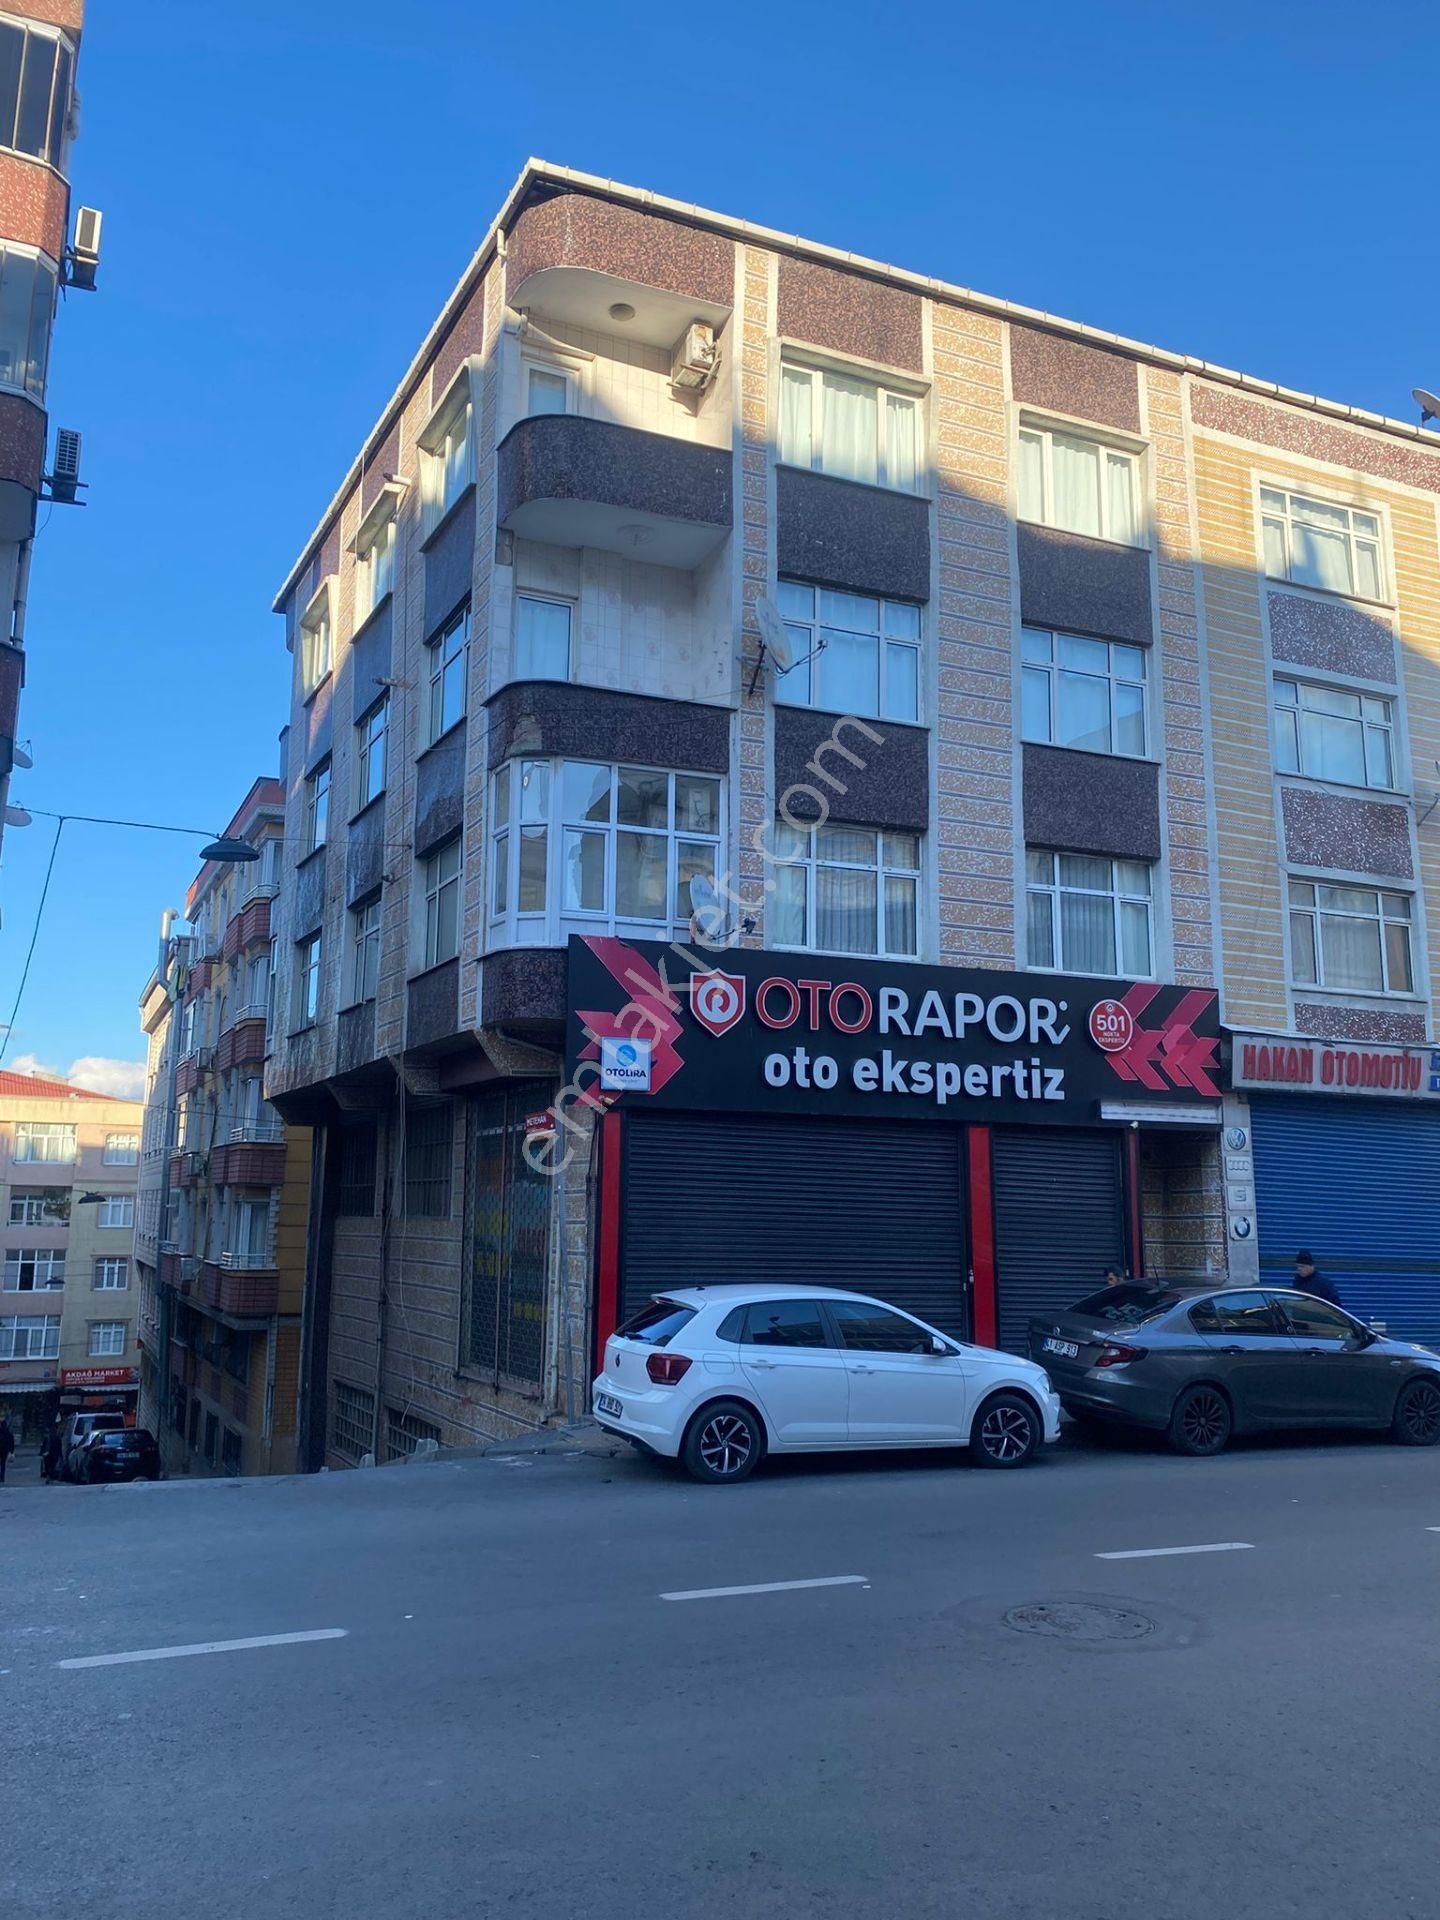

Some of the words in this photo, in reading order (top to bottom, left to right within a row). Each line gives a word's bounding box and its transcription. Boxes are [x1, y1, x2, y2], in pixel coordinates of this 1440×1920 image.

[1096, 1014, 1126, 1032] 501
[764, 1046, 839, 1090] oto
[852, 1050, 1066, 1105] ekspertiz
[1242, 1044, 1314, 1084] HAKAN
[94, 1369, 125, 1377] MARKET
